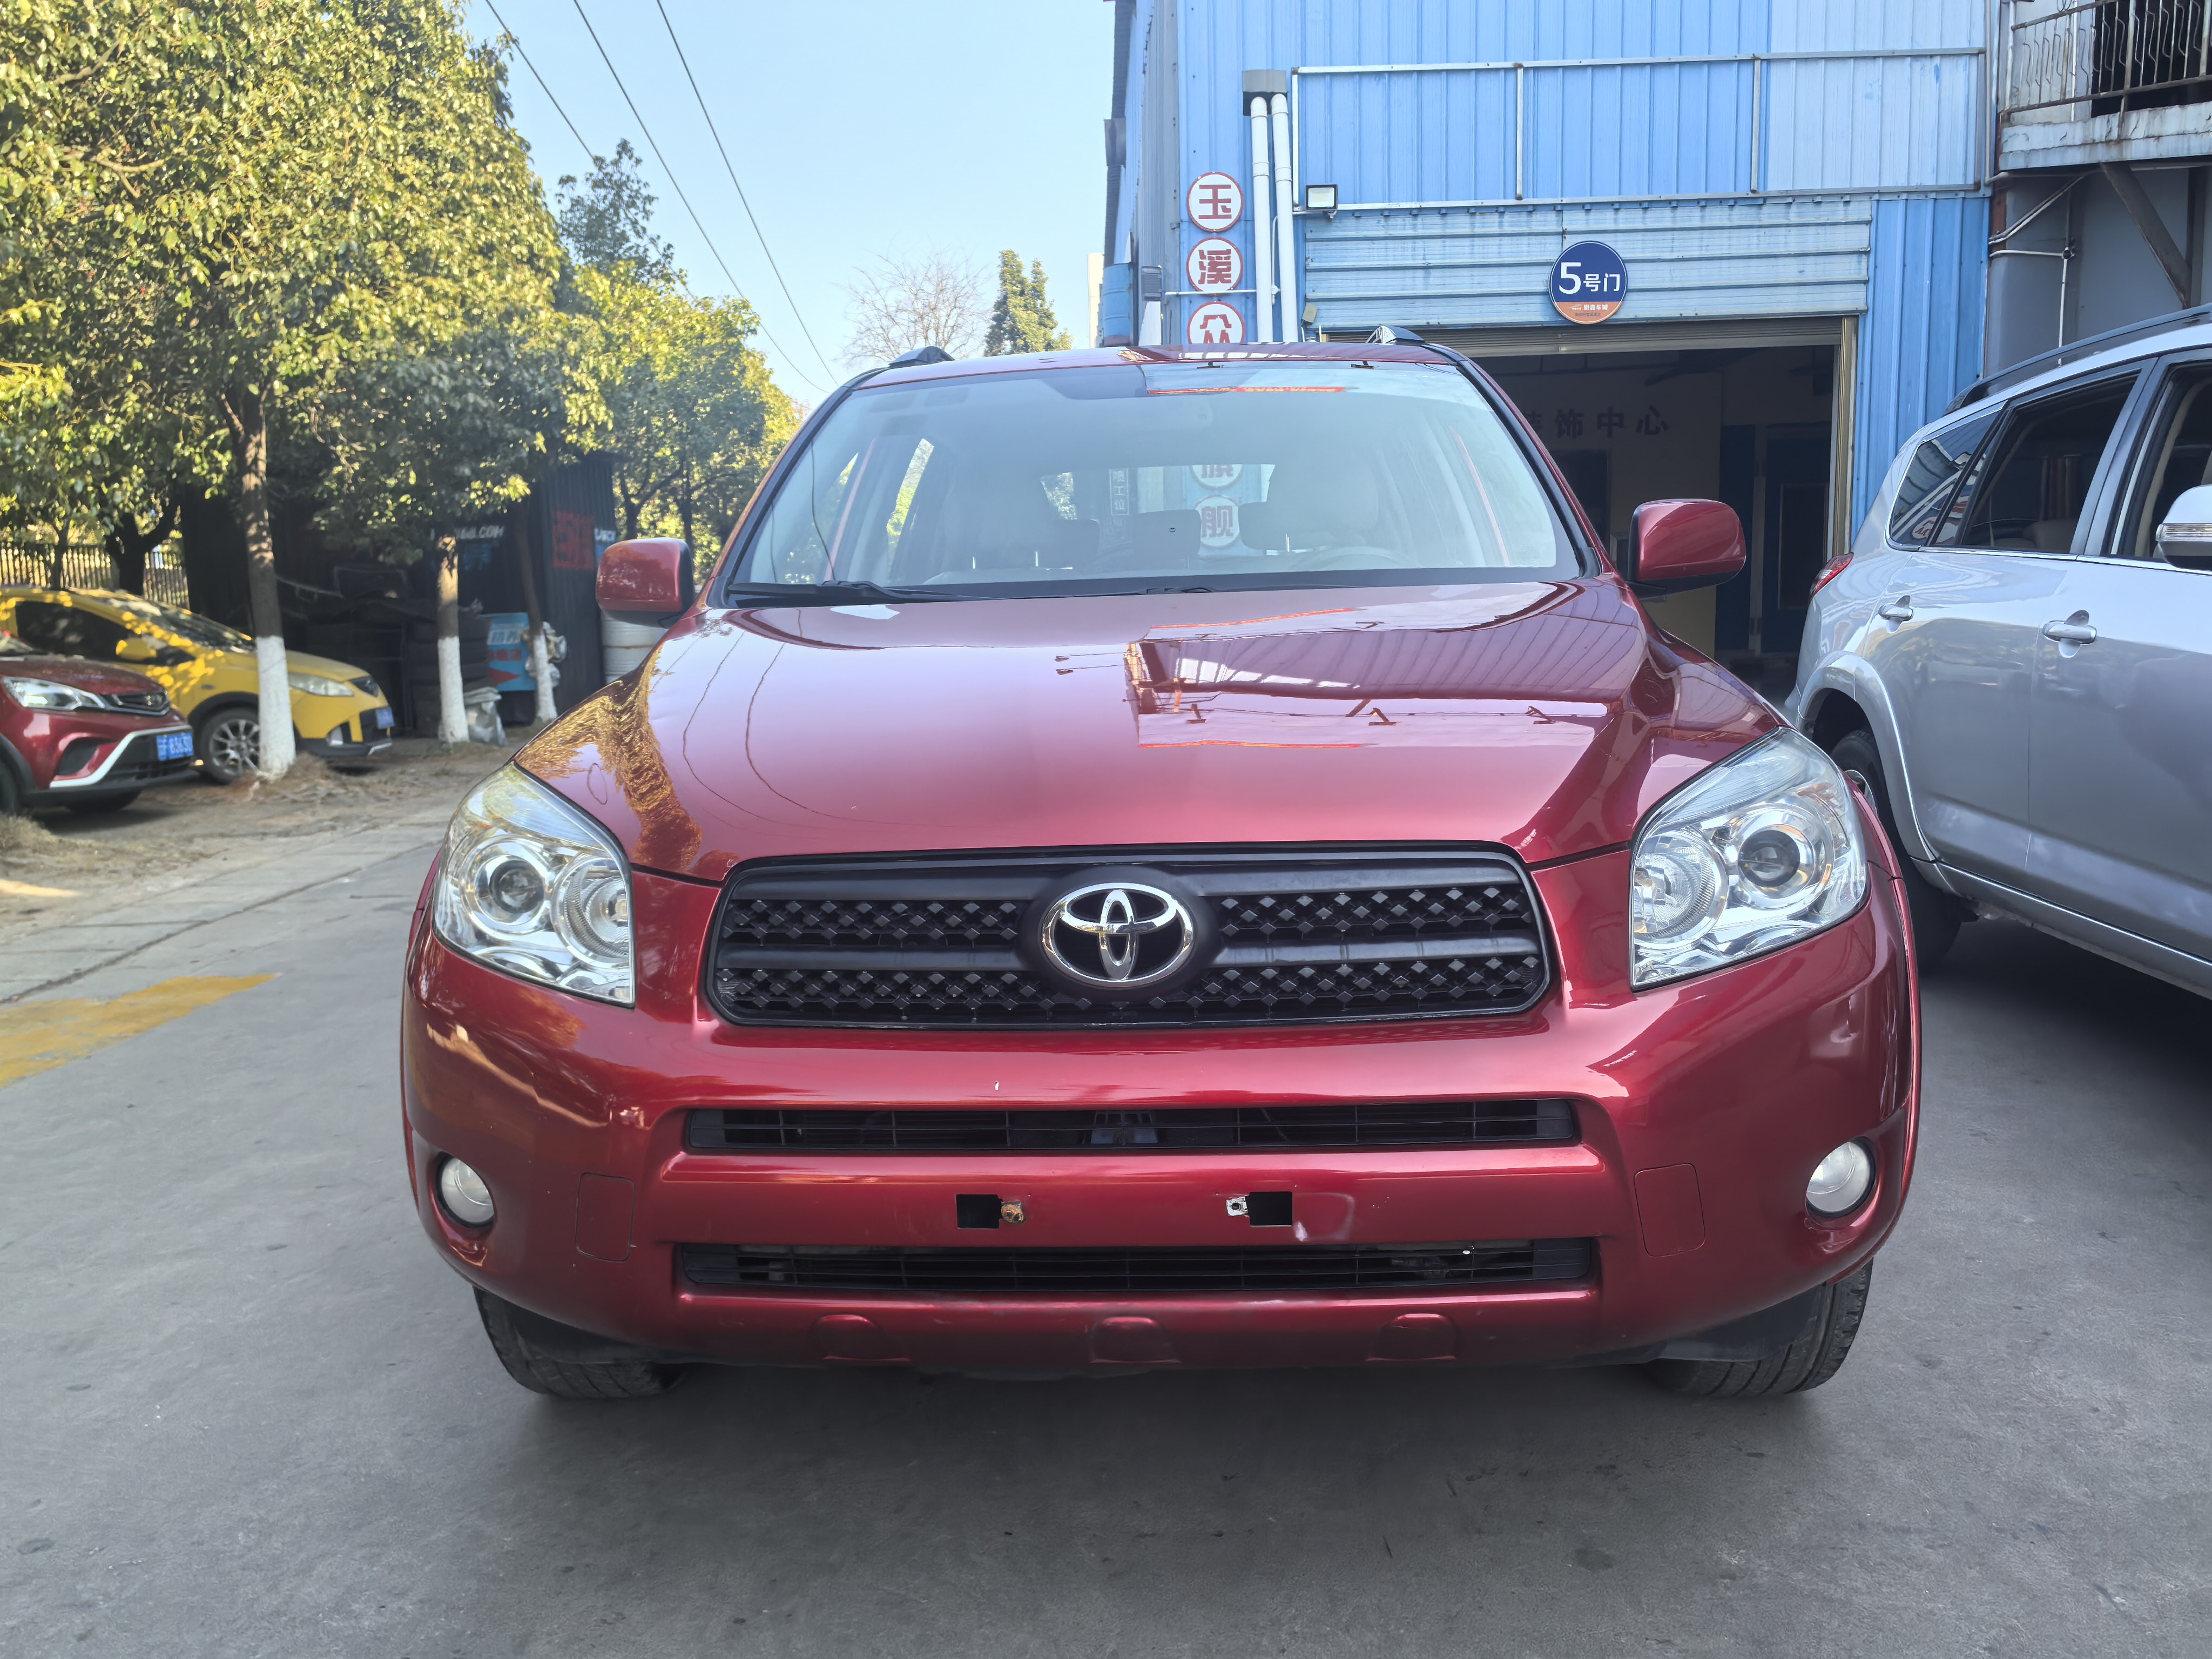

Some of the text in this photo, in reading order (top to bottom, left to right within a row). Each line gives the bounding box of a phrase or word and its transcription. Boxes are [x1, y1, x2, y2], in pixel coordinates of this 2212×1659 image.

[1198, 184, 1232, 343] 玉溪众
[1559, 261, 1621, 294] 5号门
